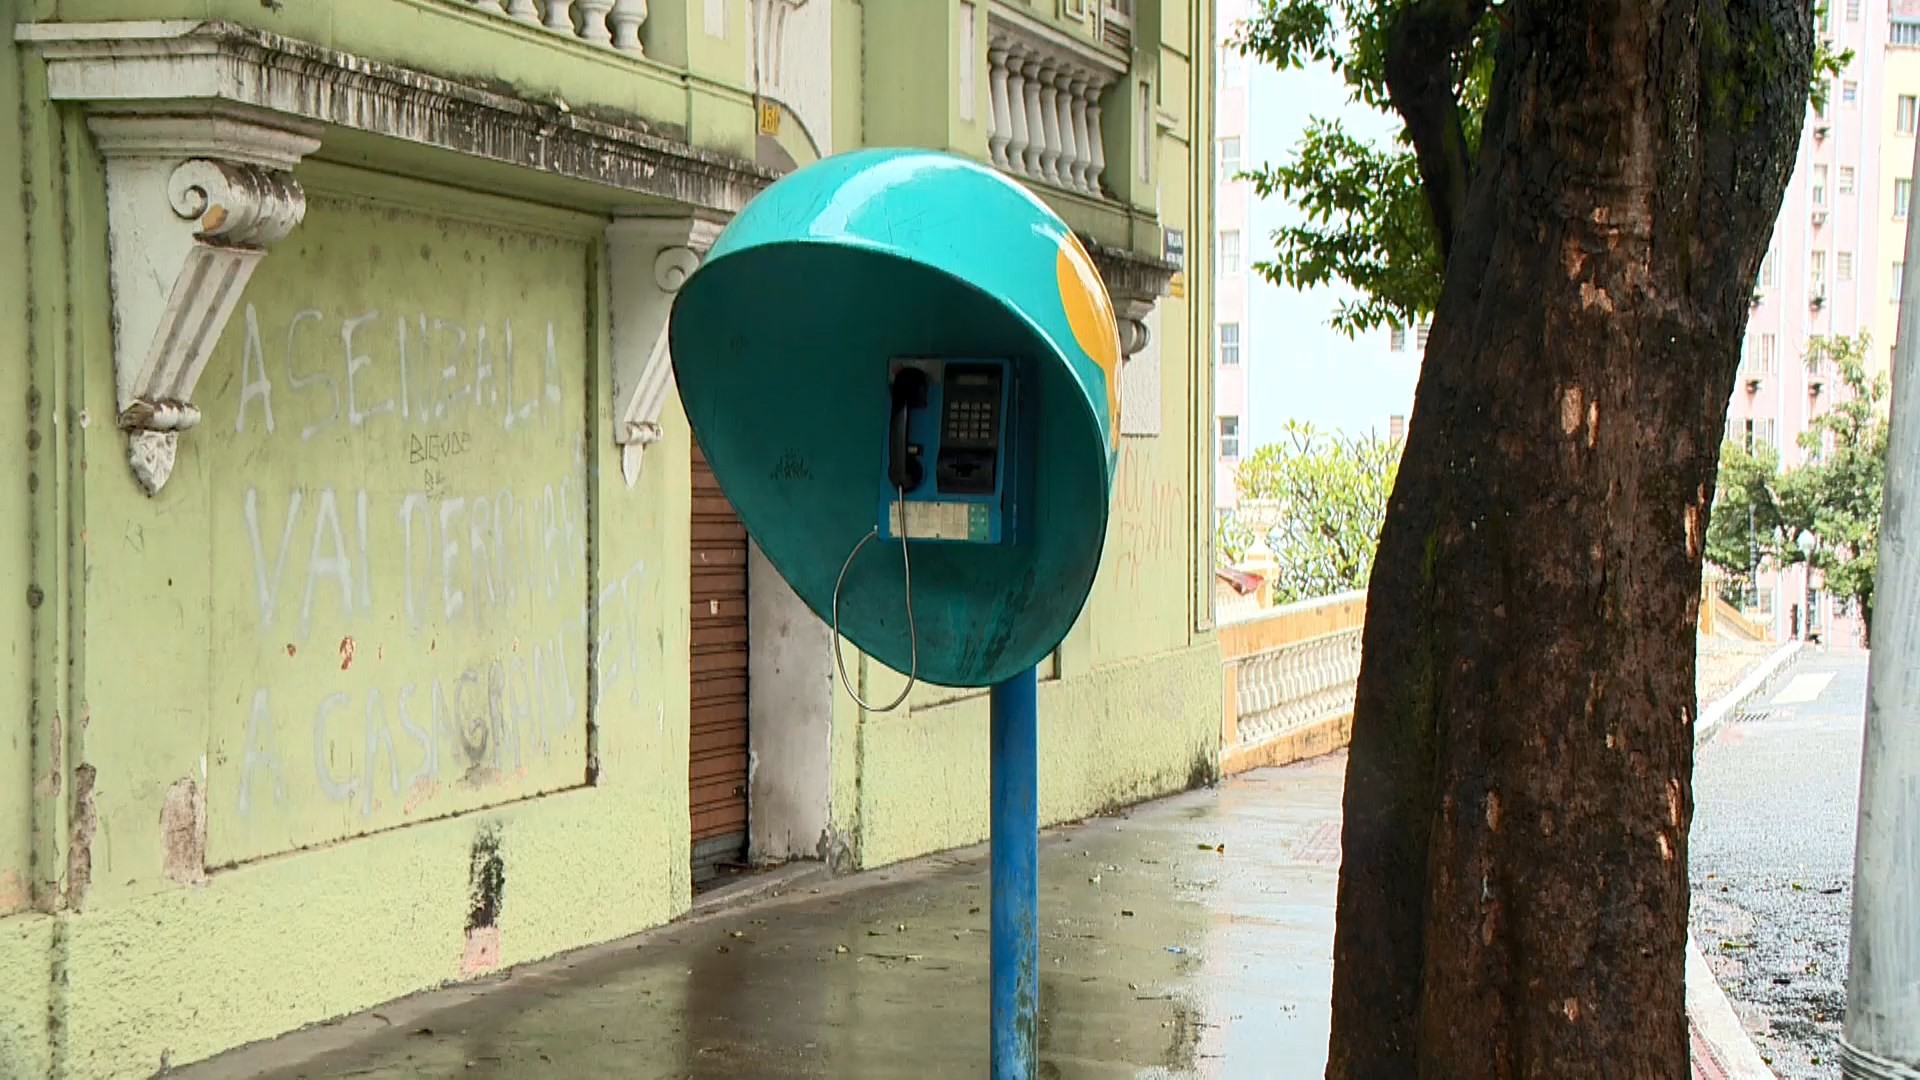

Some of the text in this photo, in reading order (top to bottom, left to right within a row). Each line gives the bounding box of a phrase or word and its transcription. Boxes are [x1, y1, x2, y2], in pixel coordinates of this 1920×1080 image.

[234, 302, 275, 435] A
[243, 486, 374, 642] VAI
[238, 686, 284, 819] A
